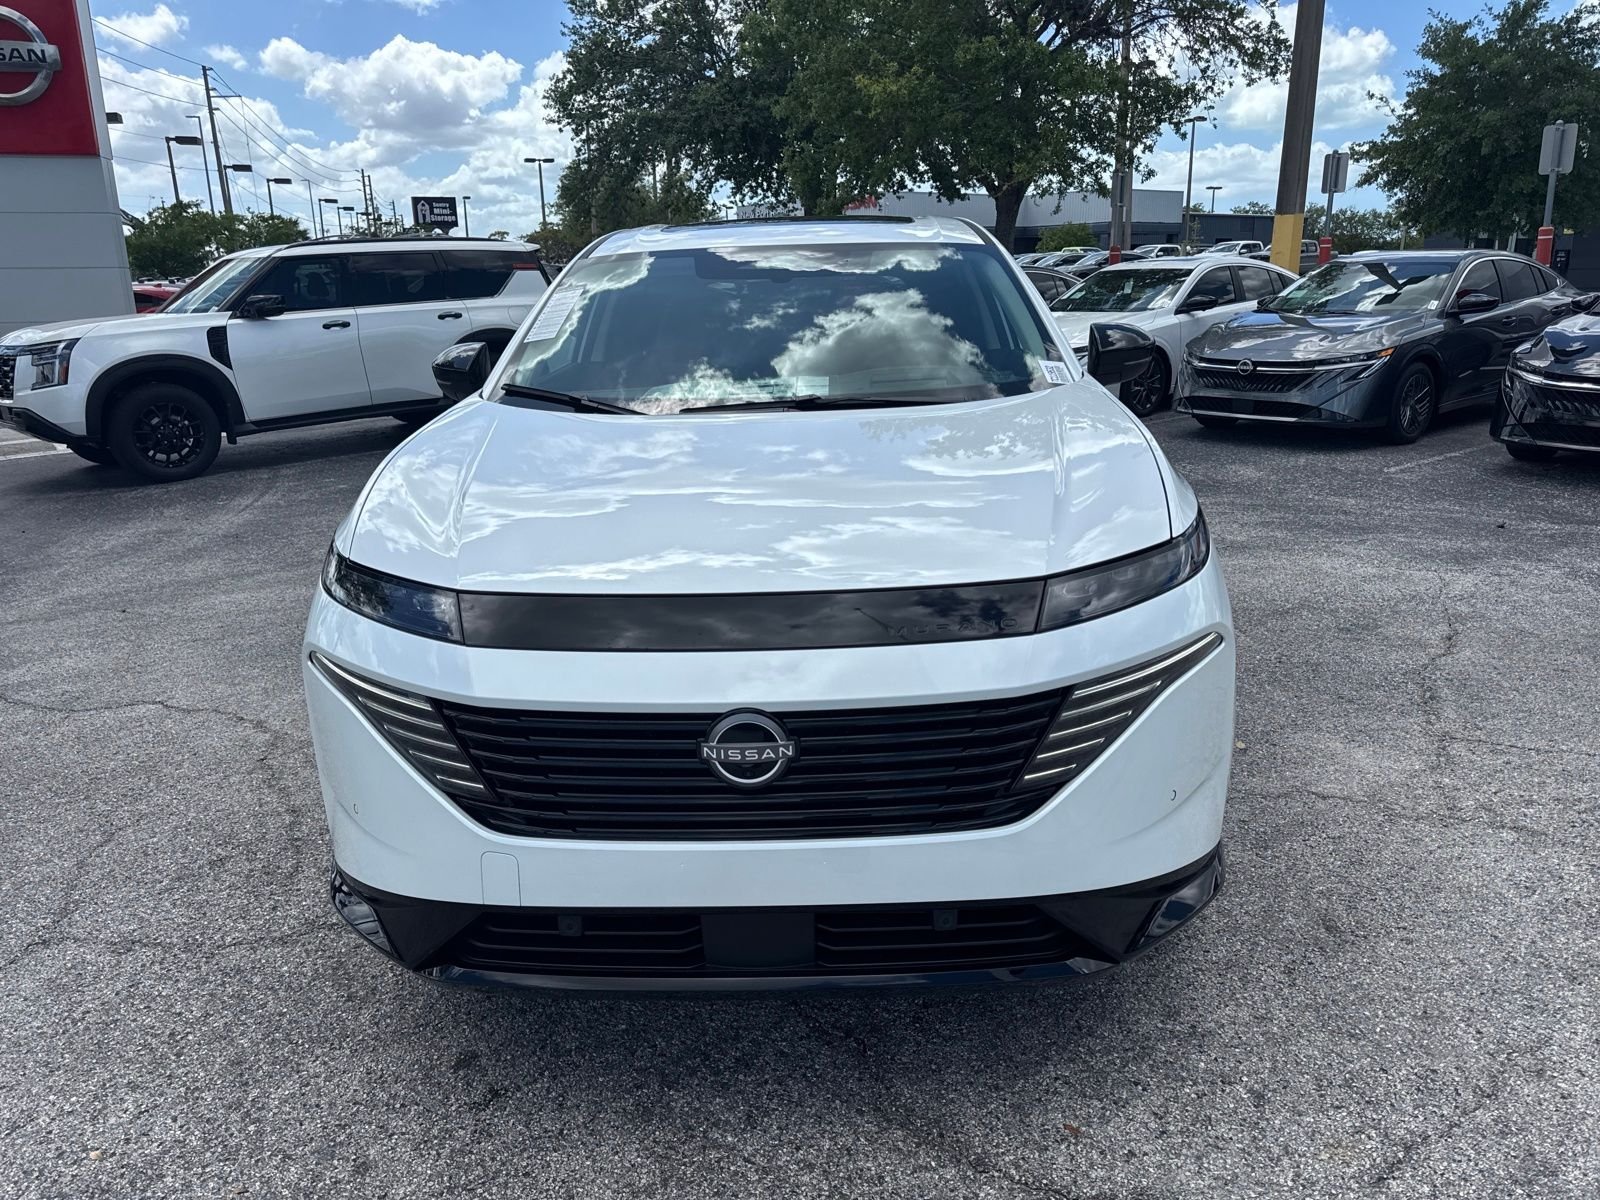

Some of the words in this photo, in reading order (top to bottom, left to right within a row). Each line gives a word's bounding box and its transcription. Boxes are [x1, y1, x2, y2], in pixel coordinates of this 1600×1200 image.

[430, 214, 456, 222] Storage
[889, 617, 1018, 636] MURANO
[703, 745, 793, 760] NISSAN
